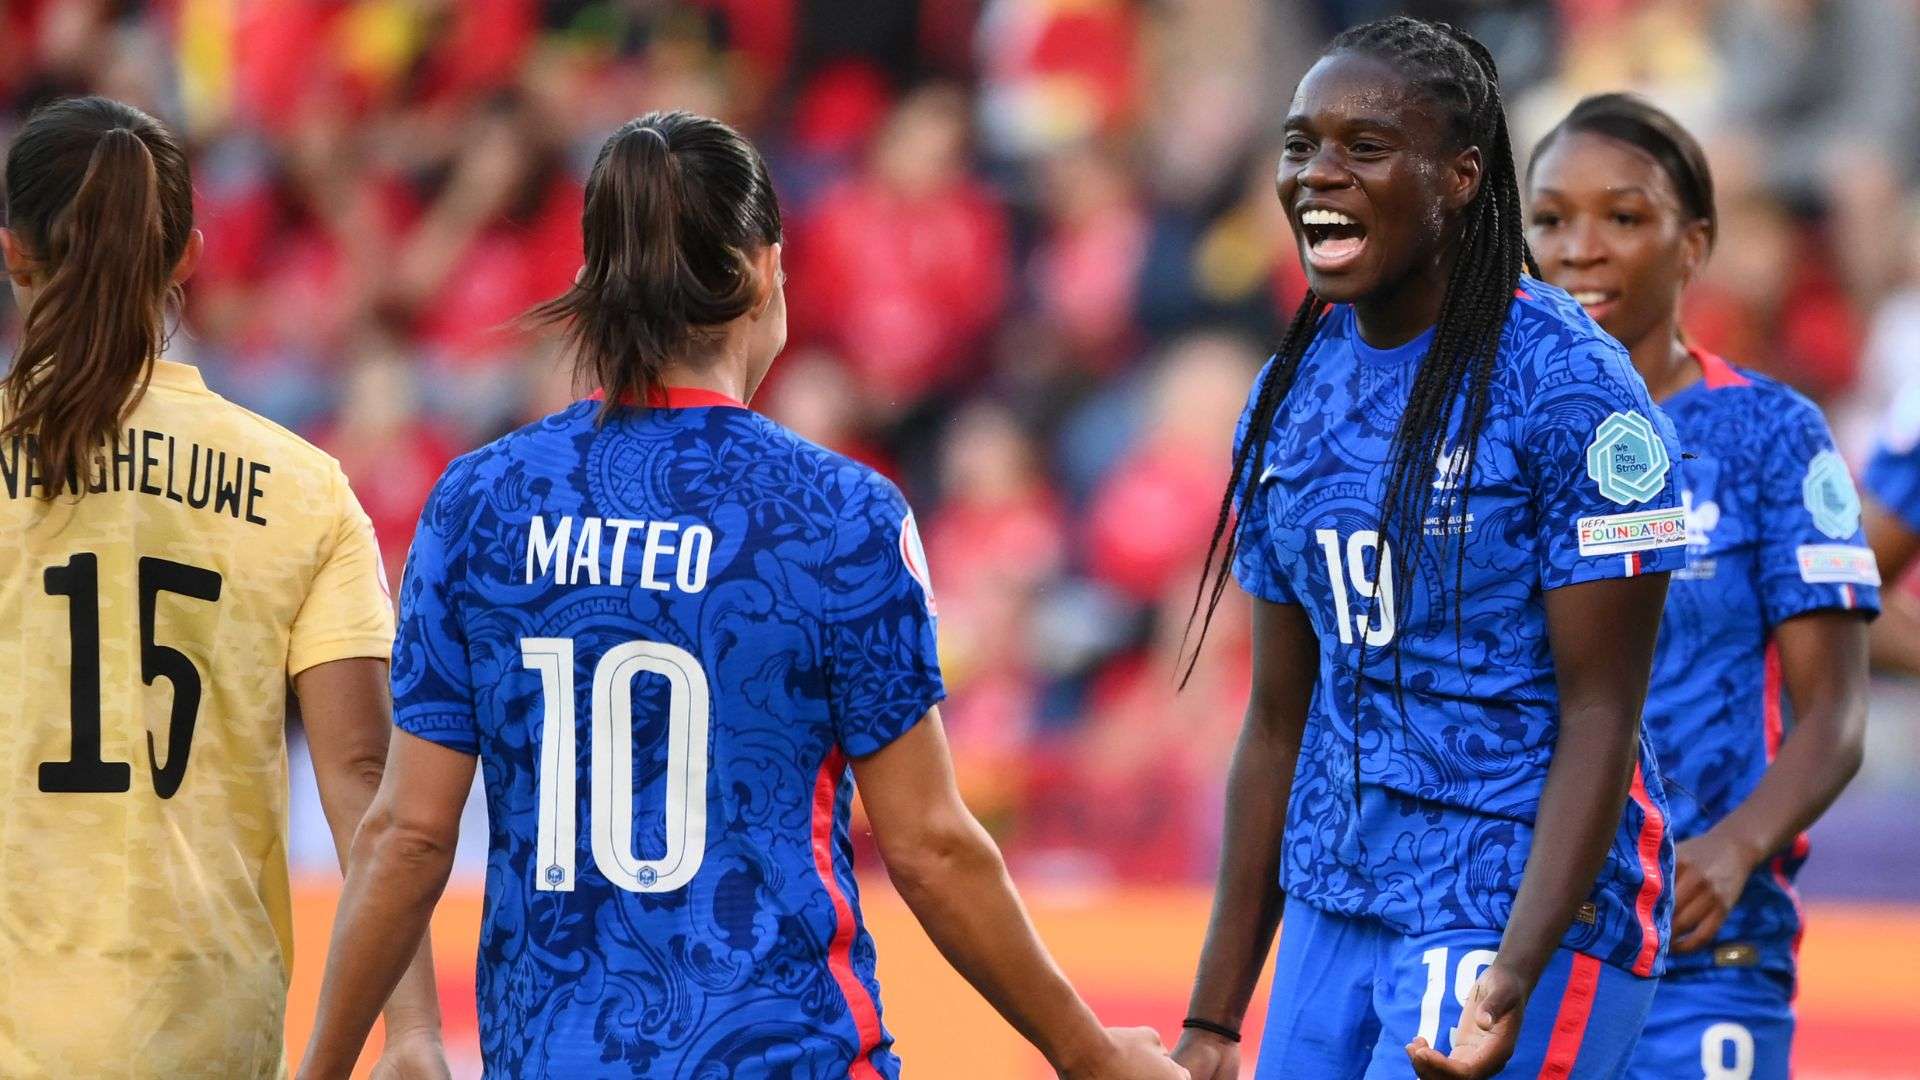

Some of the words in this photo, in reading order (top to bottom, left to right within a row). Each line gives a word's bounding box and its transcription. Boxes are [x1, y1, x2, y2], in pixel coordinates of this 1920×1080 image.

[1615, 444, 1628, 452] We
[1616, 454, 1635, 464] Play
[1616, 463, 1647, 473] Strong
[1581, 519, 1606, 529] UEFA
[526, 515, 713, 594] MATEO
[1315, 529, 1395, 647] 19
[38, 552, 223, 799] 15
[520, 637, 709, 893] 10
